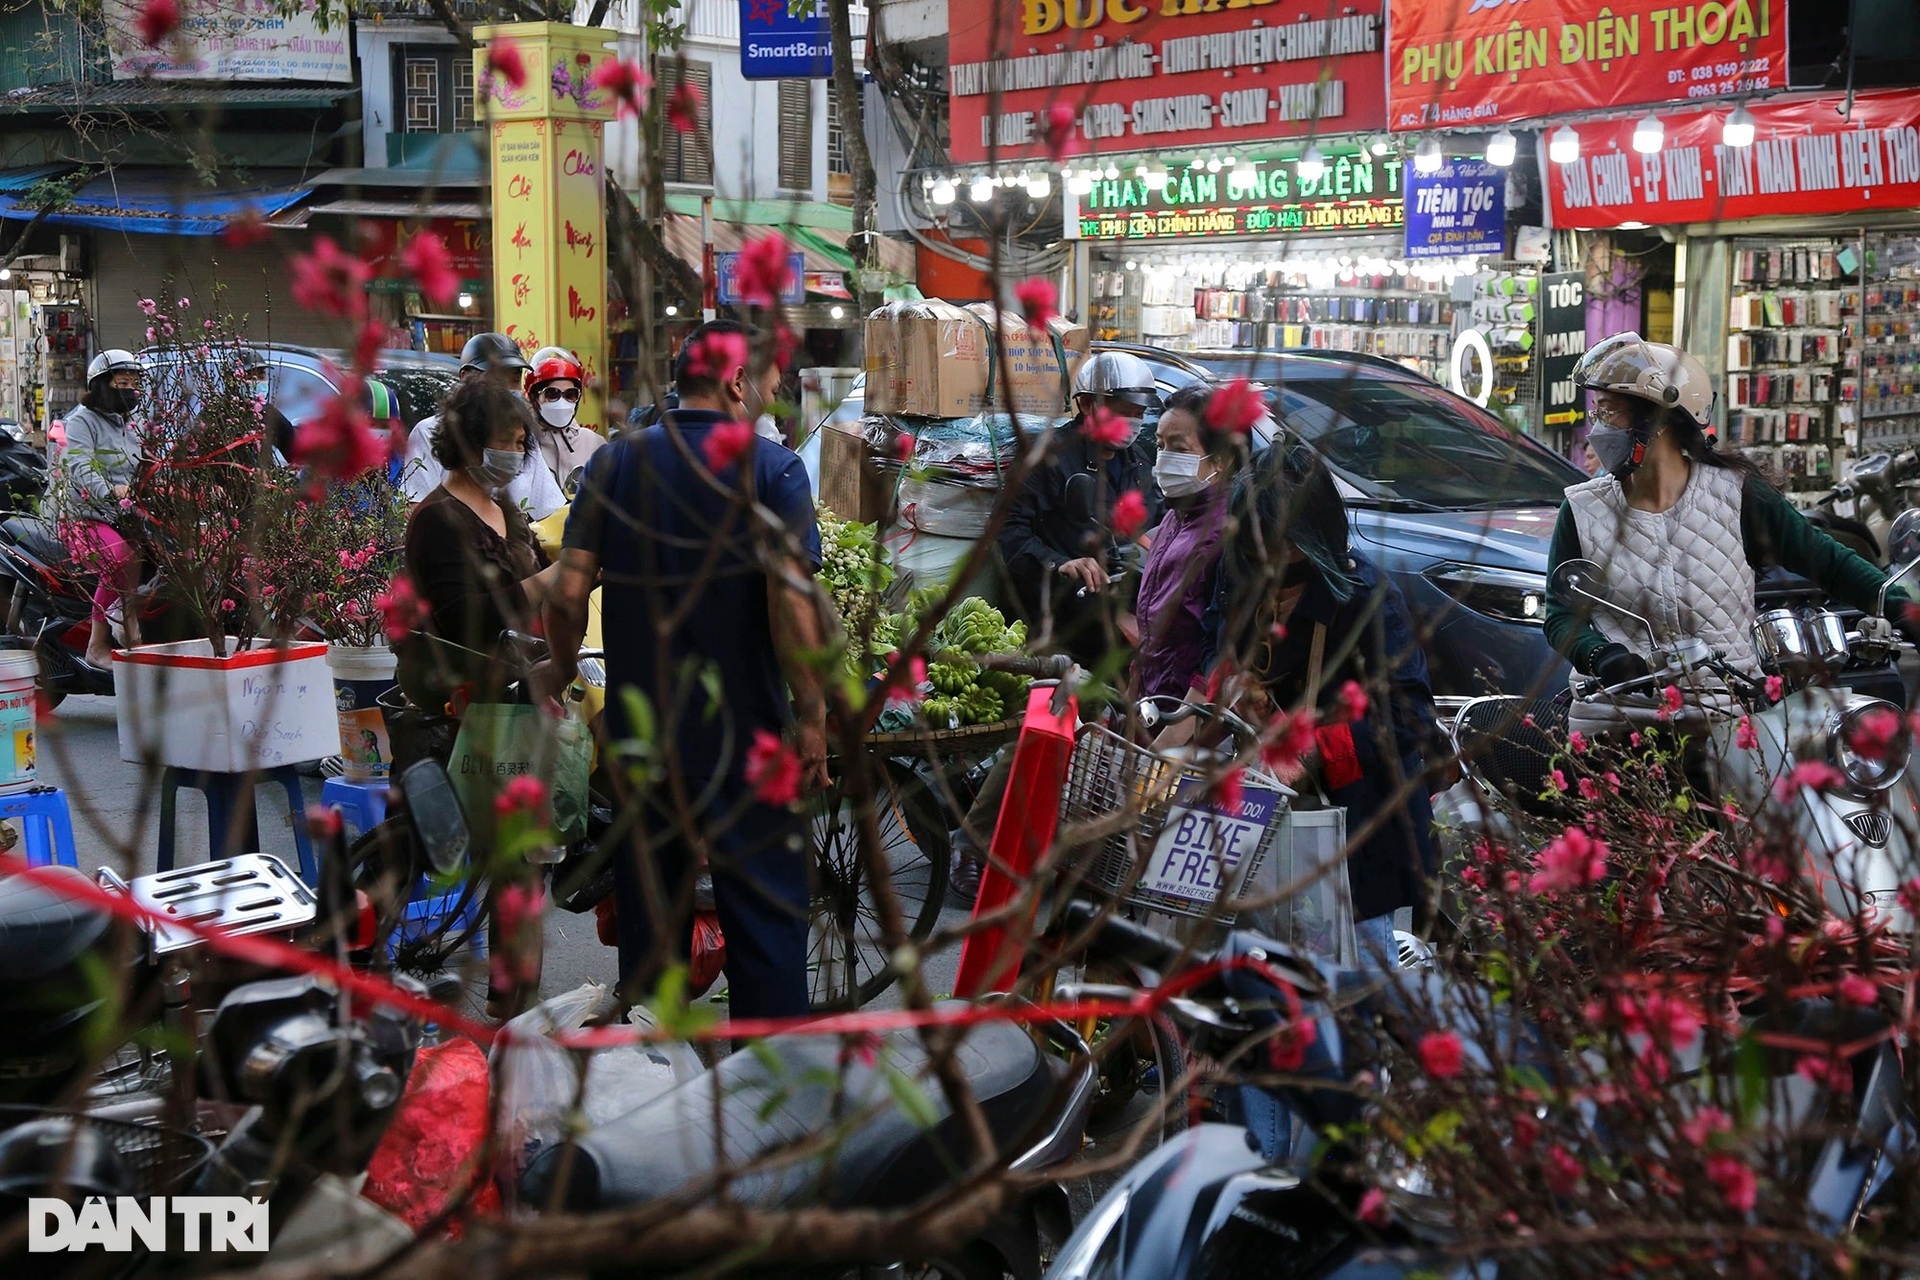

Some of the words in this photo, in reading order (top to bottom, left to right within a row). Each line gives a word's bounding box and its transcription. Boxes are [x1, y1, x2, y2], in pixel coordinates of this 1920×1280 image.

[950, 63, 981, 96] THAY
[1015, 48, 1047, 90] MÀN
[1083, 35, 1117, 83] CẢM
[1162, 36, 1201, 74] LINH
[1201, 32, 1236, 78] PHỤ
[1235, 19, 1276, 73] KIỆN
[1276, 13, 1327, 62] CHÍNH
[1331, 7, 1377, 55] HÃNG
[1403, 39, 1464, 91] PHỤ
[1474, 20, 1548, 84] KIỆN
[1559, 7, 1640, 72] ĐIỆN
[1650, 0, 1770, 53] THOẠI
[1691, 66, 1713, 82] 038
[1715, 63, 1738, 78] 969
[1688, 83, 1716, 98] 0963
[1719, 80, 1734, 94] 25
[1083, 103, 1125, 139] OPPO
[1132, 94, 1213, 136] SAMSUNG
[1221, 88, 1268, 127] SONY
[1279, 80, 1344, 121] XIAOMI
[1442, 104, 1472, 121] HÀNG
[1473, 100, 1499, 116] GIẤY
[563, 149, 597, 176] Chúc
[1664, 136, 1704, 201] KÍNH
[1713, 144, 1754, 197] THAY
[1756, 128, 1796, 194] MÀN
[1797, 124, 1839, 191] HÌNH
[1840, 118, 1884, 199] ĐIỆN
[1090, 178, 1150, 208] THAY
[1162, 168, 1217, 205] CẢM
[1297, 156, 1373, 202] ĐIỆN
[1416, 183, 1458, 216] TIỆM
[1462, 181, 1495, 212] TÓC
[1158, 213, 1198, 234] CHÍNH
[1431, 215, 1455, 228] NAM
[1462, 212, 1477, 227] NỮ
[1548, 279, 1583, 309] TÓC
[1545, 330, 1586, 358] NAM
[1015, 362, 1023, 372] 10
[1174, 812, 1252, 858] BIKE
[1160, 847, 1238, 890] FREE
